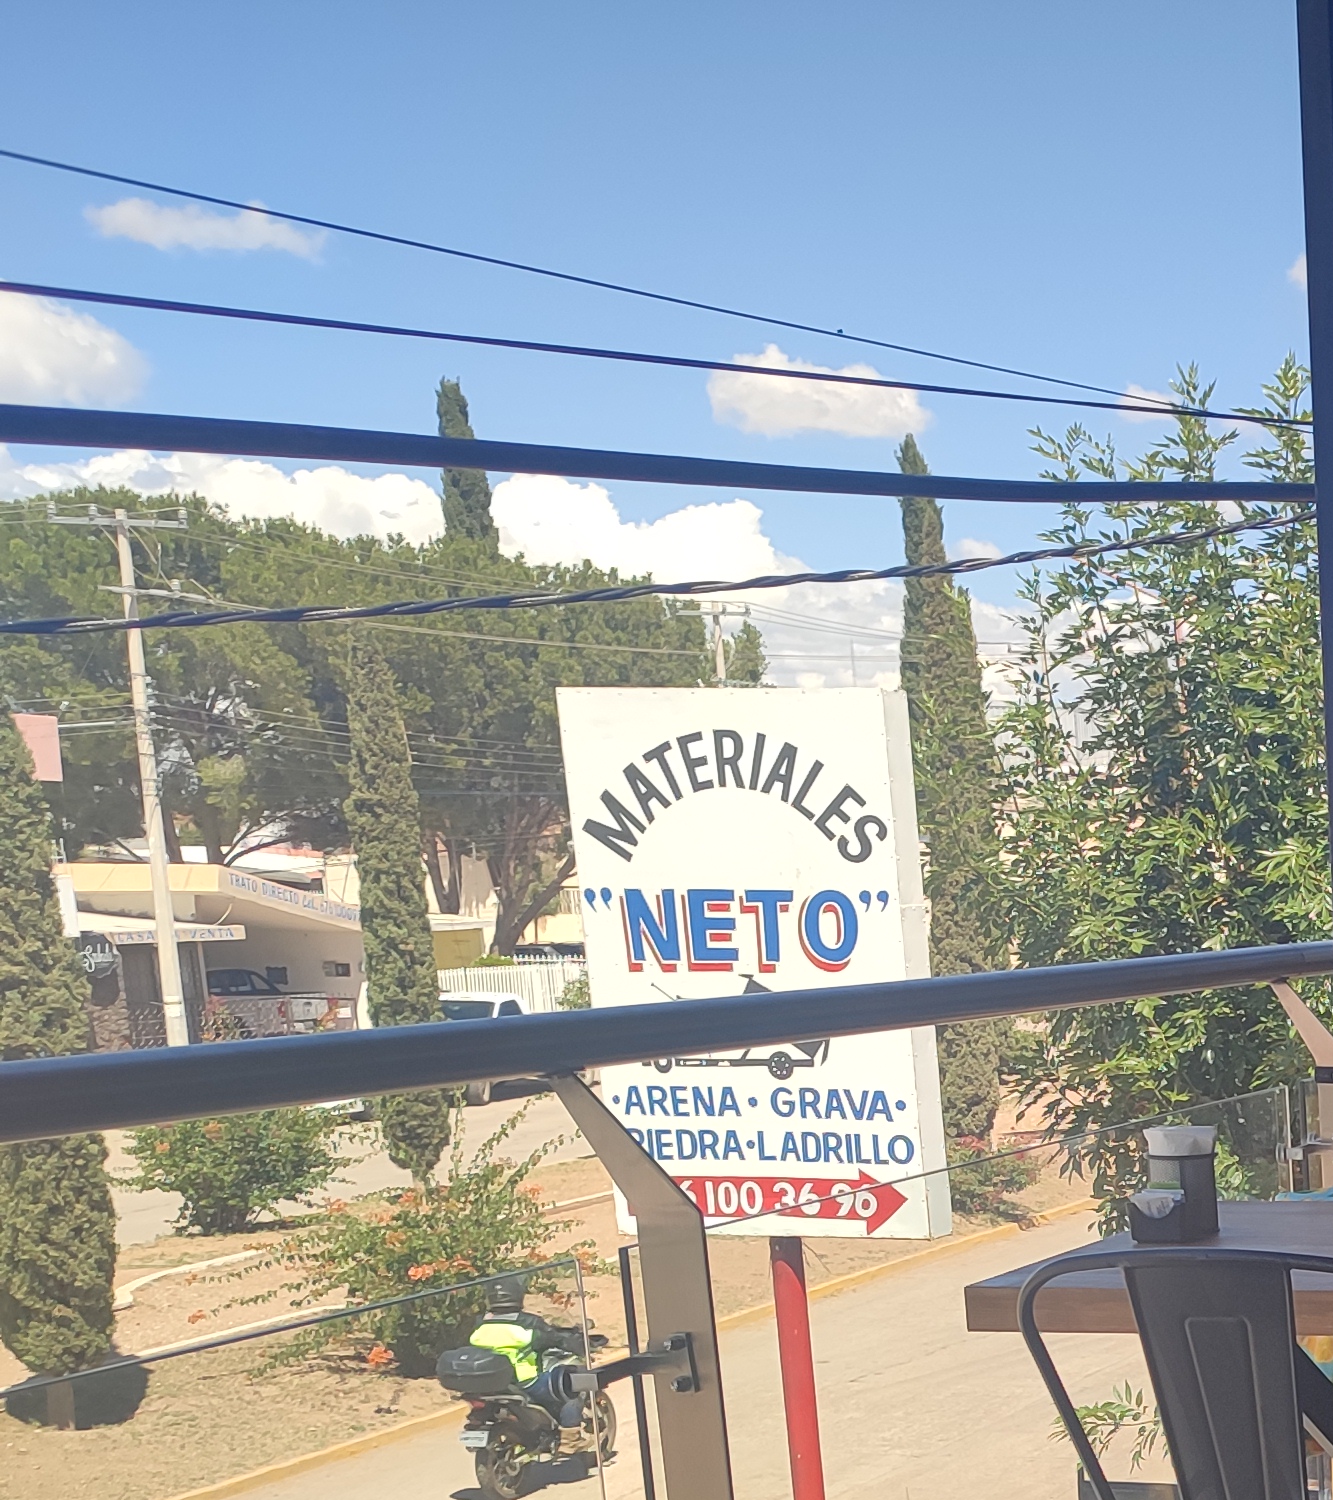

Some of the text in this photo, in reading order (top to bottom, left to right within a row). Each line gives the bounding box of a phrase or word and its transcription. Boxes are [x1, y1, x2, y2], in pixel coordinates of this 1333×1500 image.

[582, 728, 888, 864] MATERIALES
[229, 873, 258, 893] TRATO
[261, 882, 299, 905] DIRECTO
[117, 930, 156, 943] CASA
[190, 927, 235, 939] VENTA
[625, 1085, 895, 1122] ARENA GRAVA
[703, 1180, 764, 1216] 100
[772, 1181, 822, 1216] 36
[830, 1182, 878, 1219] 96
